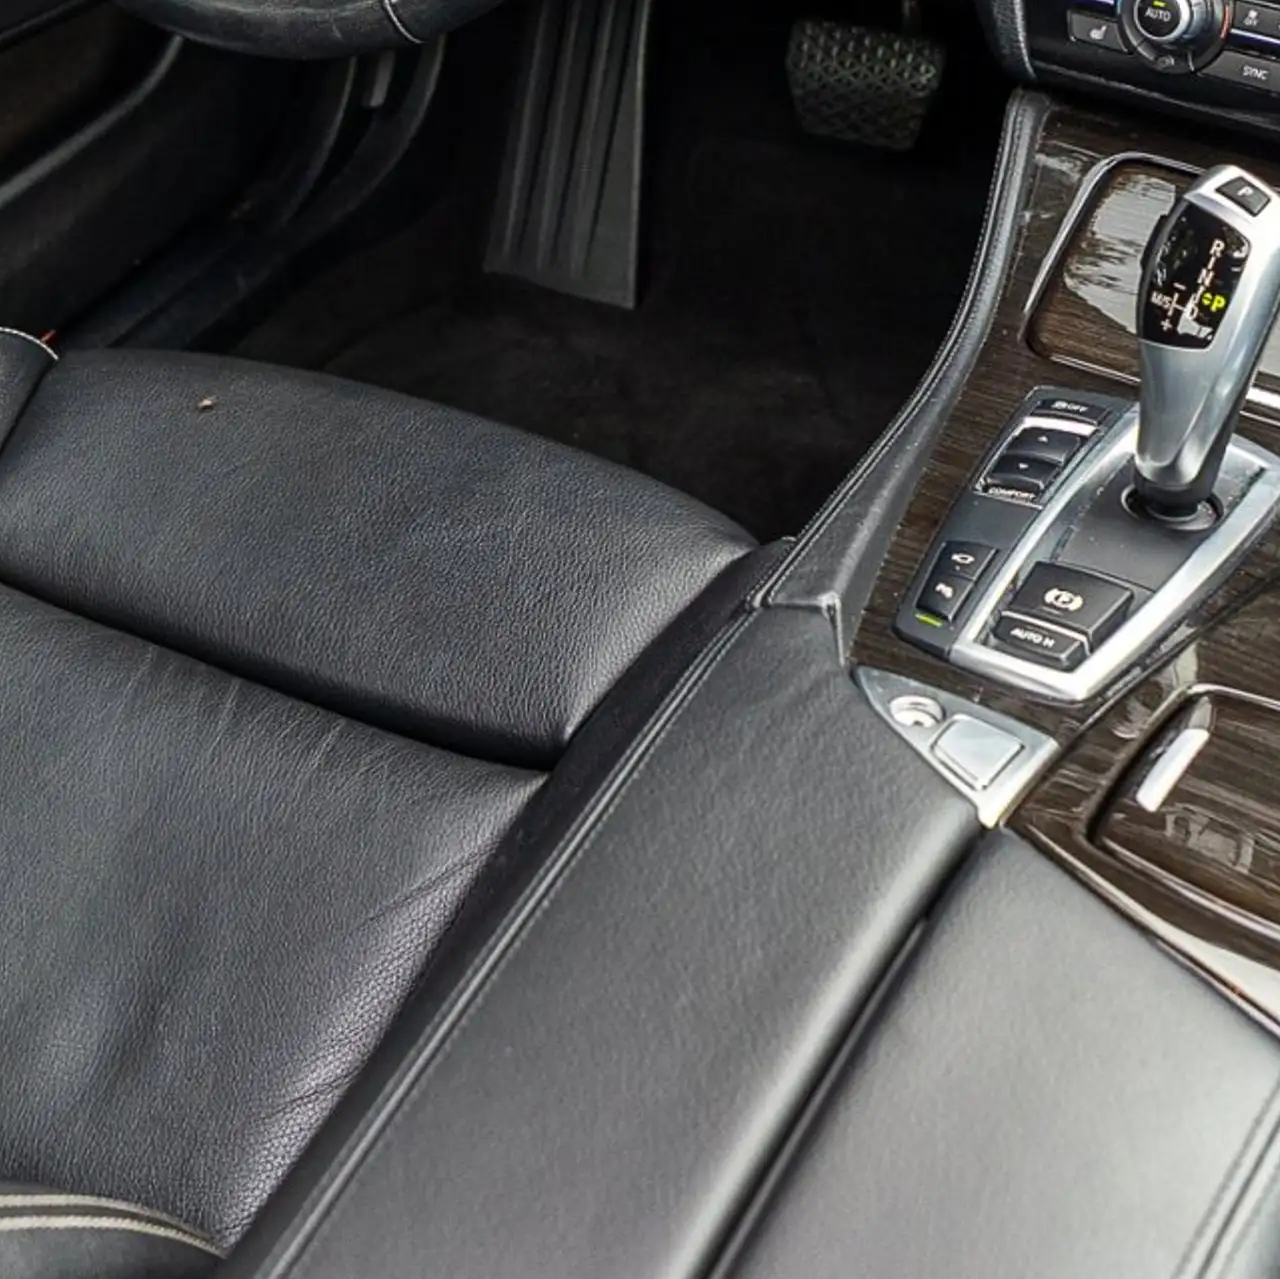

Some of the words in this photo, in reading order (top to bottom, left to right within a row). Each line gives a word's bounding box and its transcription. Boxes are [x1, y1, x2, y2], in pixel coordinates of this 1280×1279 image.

[1144, 6, 1171, 22] AUTO
[1243, 64, 1269, 81] SYNC
[1237, 186, 1253, 197] P
[1210, 238, 1226, 257] R
[1197, 268, 1215, 287] N
[1211, 296, 1226, 313] P
[1010, 627, 1042, 644] AUTO
[1043, 635, 1056, 648] H
